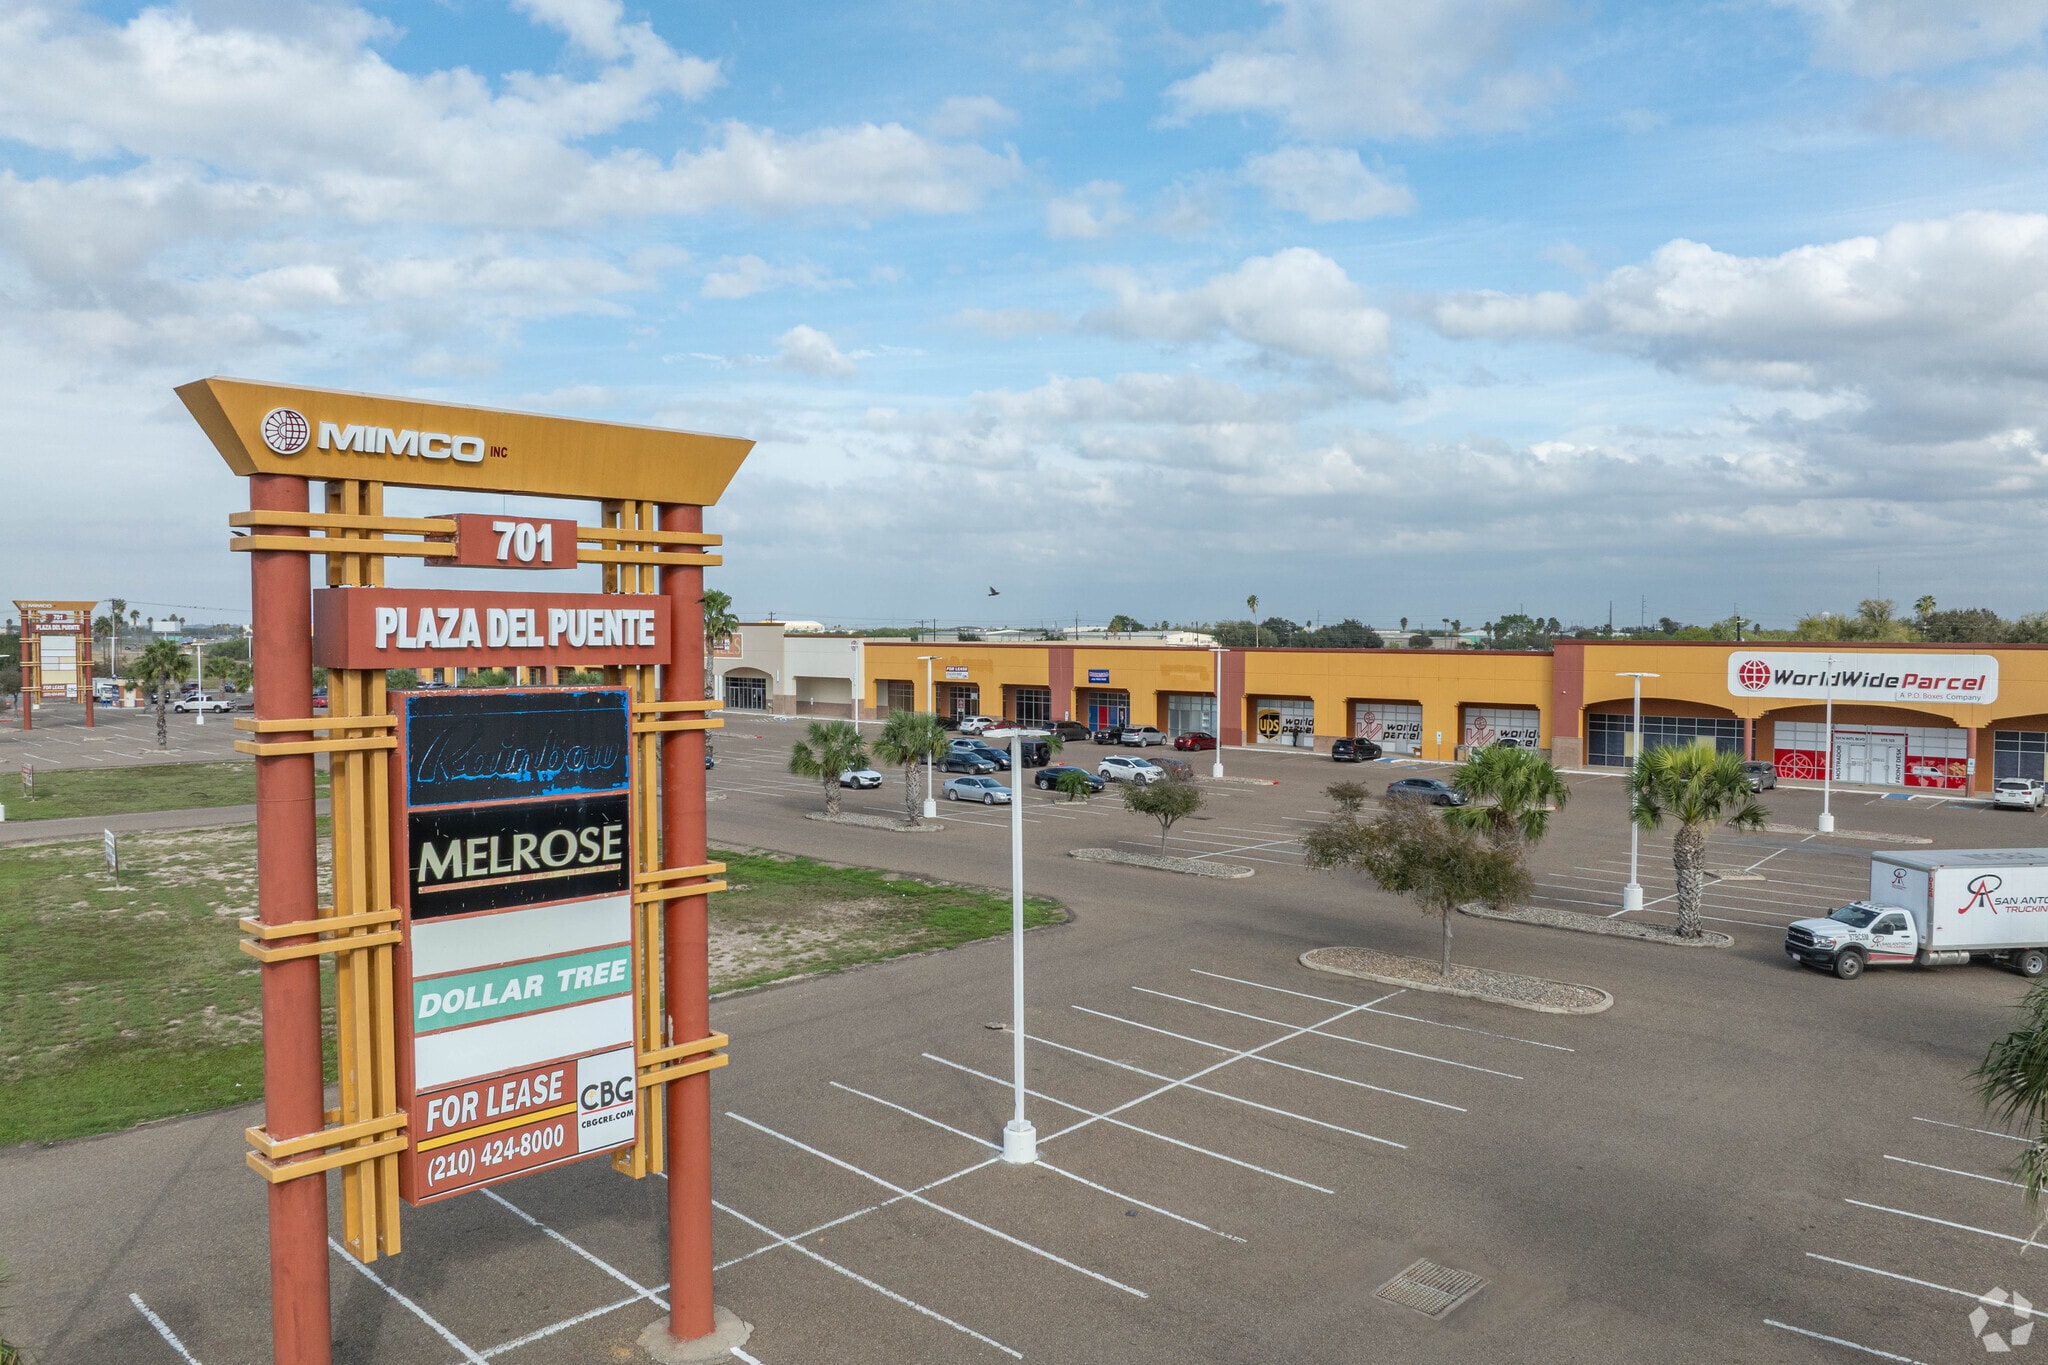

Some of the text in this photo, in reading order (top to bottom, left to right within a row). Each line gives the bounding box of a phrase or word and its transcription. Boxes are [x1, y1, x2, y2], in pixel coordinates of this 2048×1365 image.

[317, 421, 508, 463] MIMCO INC
[492, 521, 553, 562] 701
[376, 607, 655, 648] PLAZA DEL PUENTE
[1946, 693, 1981, 701] Company
[1285, 717, 1314, 726] world
[1383, 731, 1419, 740] parcel
[1387, 722, 1419, 732] world
[1501, 729, 1537, 739] world
[417, 824, 623, 882] MELROSE
[1994, 897, 2018, 905] SAN
[418, 958, 628, 1019] DOLLAR TREE
[426, 1070, 564, 1132] FOR LEASE
[581, 1076, 633, 1110] CBG
[581, 1109, 634, 1129] CBGCRE.COM
[427, 1124, 564, 1187] (210) 424-8000
